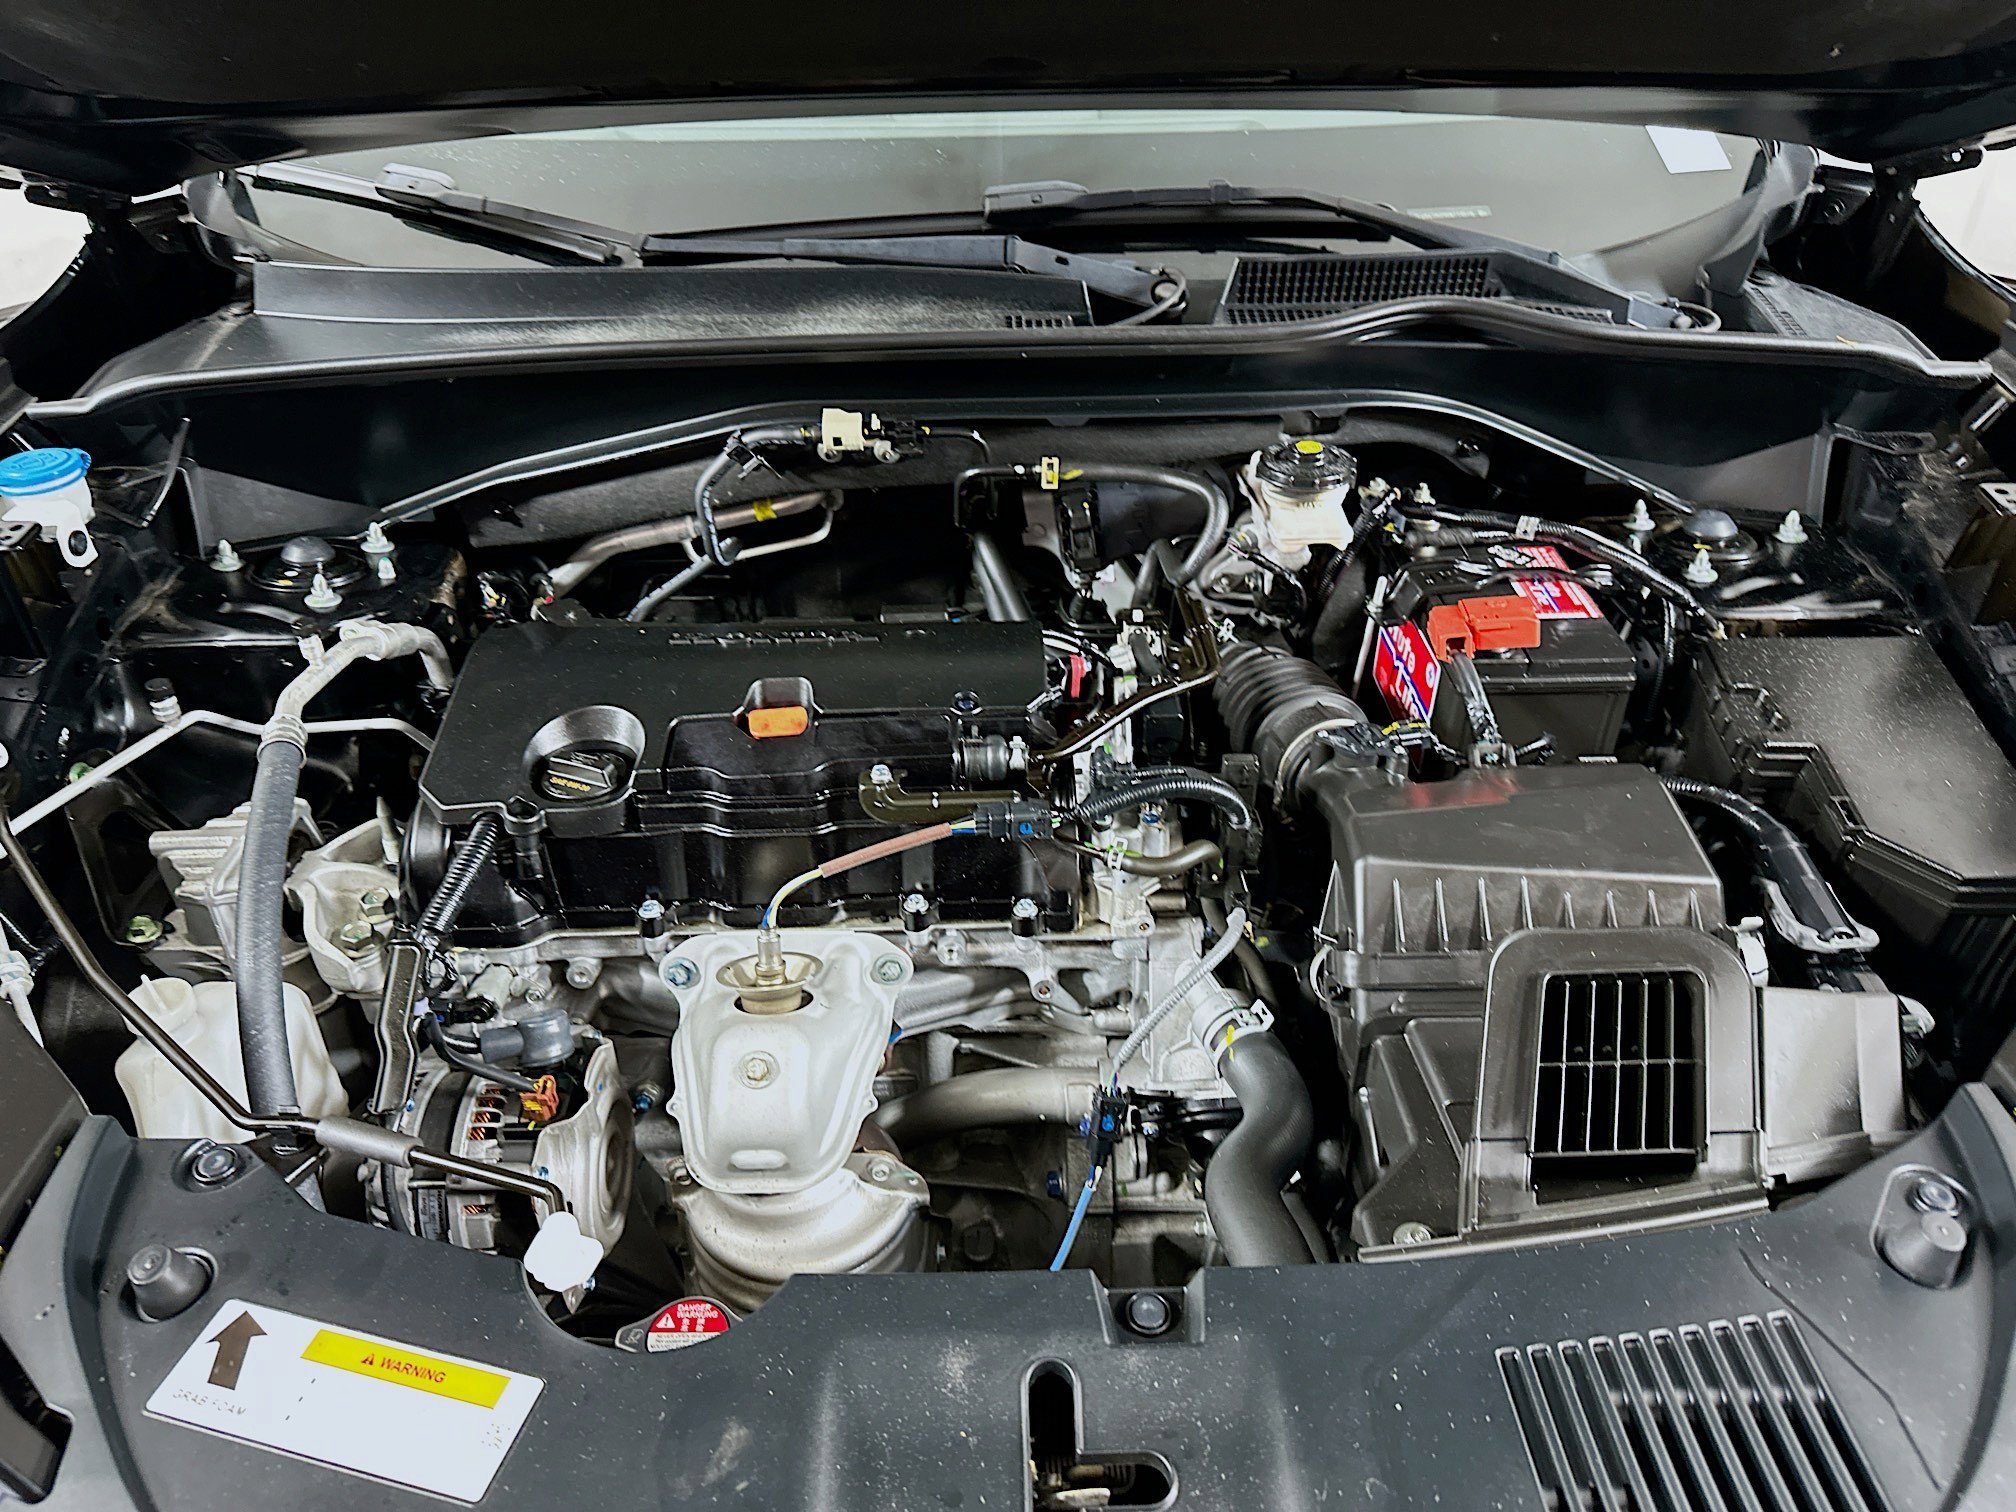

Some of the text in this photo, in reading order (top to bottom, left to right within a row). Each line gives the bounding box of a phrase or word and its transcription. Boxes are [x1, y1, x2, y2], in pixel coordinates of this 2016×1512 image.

[677, 1303, 711, 1311] DANGER
[676, 1310, 718, 1318] WARNING
[380, 1357, 446, 1383] WARNING
